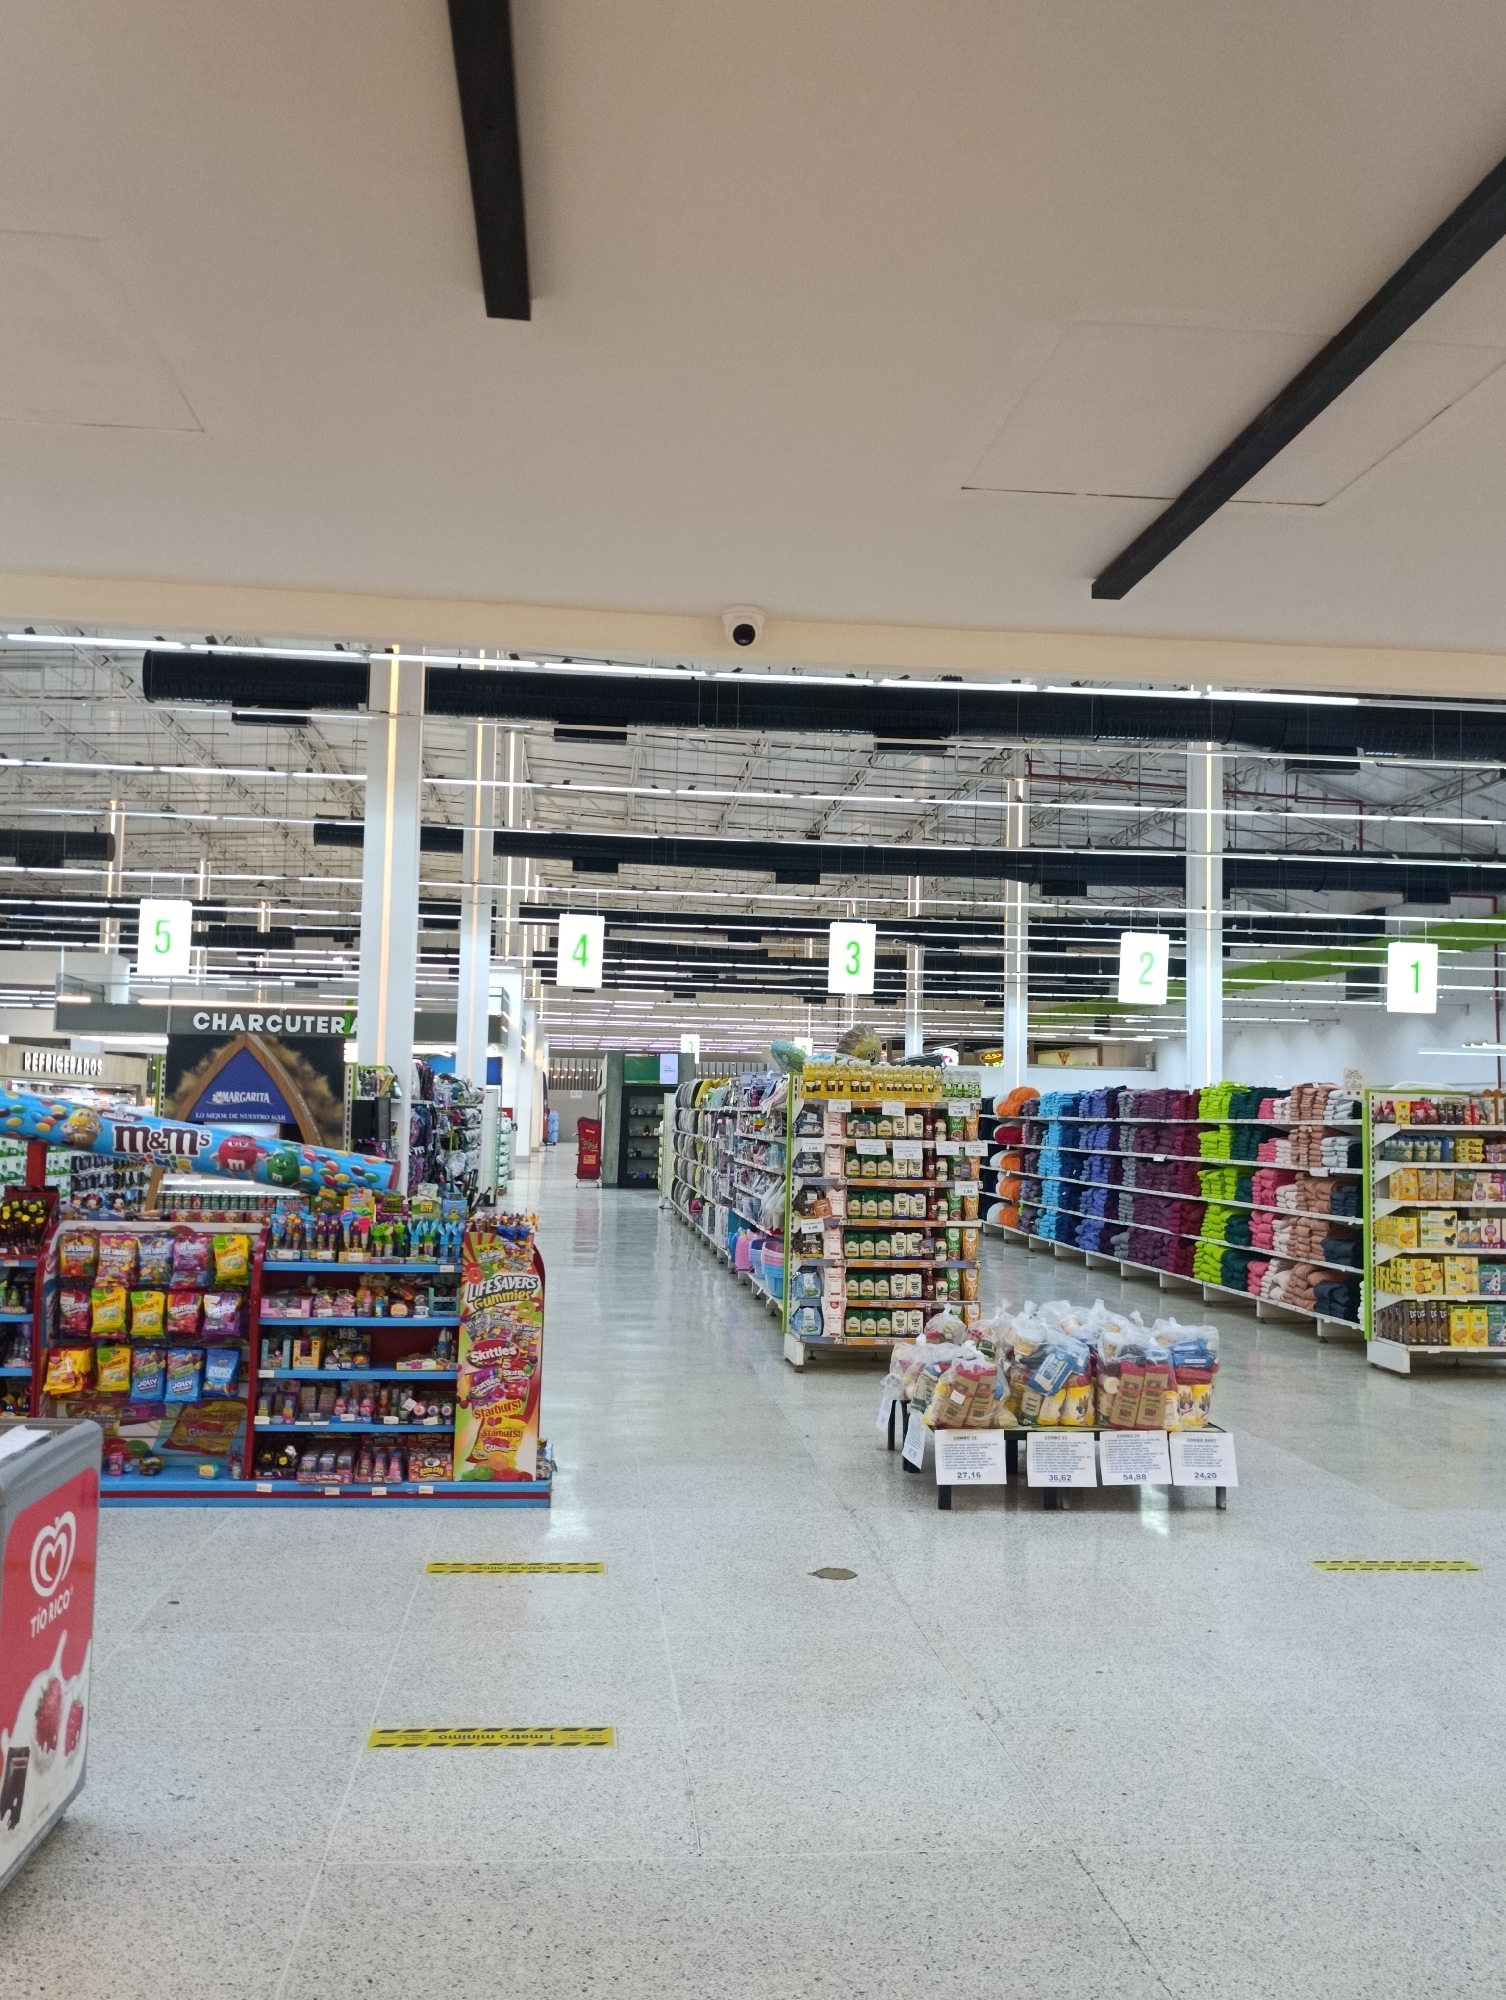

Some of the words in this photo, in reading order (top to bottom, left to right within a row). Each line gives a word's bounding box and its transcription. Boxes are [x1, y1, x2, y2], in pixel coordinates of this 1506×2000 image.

[154, 919, 171, 954] 5
[572, 934, 588, 967] 4
[845, 940, 861, 975] 3
[1138, 952, 1155, 985] 2
[1410, 961, 1419, 994] 1
[24, 1051, 103, 1076] REFRIGERADOS
[221, 1091, 270, 1104] MARGARITA
[471, 1344, 517, 1363] Skittles
[473, 1399, 521, 1420] Starburst
[482, 1429, 521, 1438] Starburst
[1048, 1474, 1072, 1482] 36,62
[48, 1589, 70, 1623] RICO
[499, 1733, 543, 1741] metro
